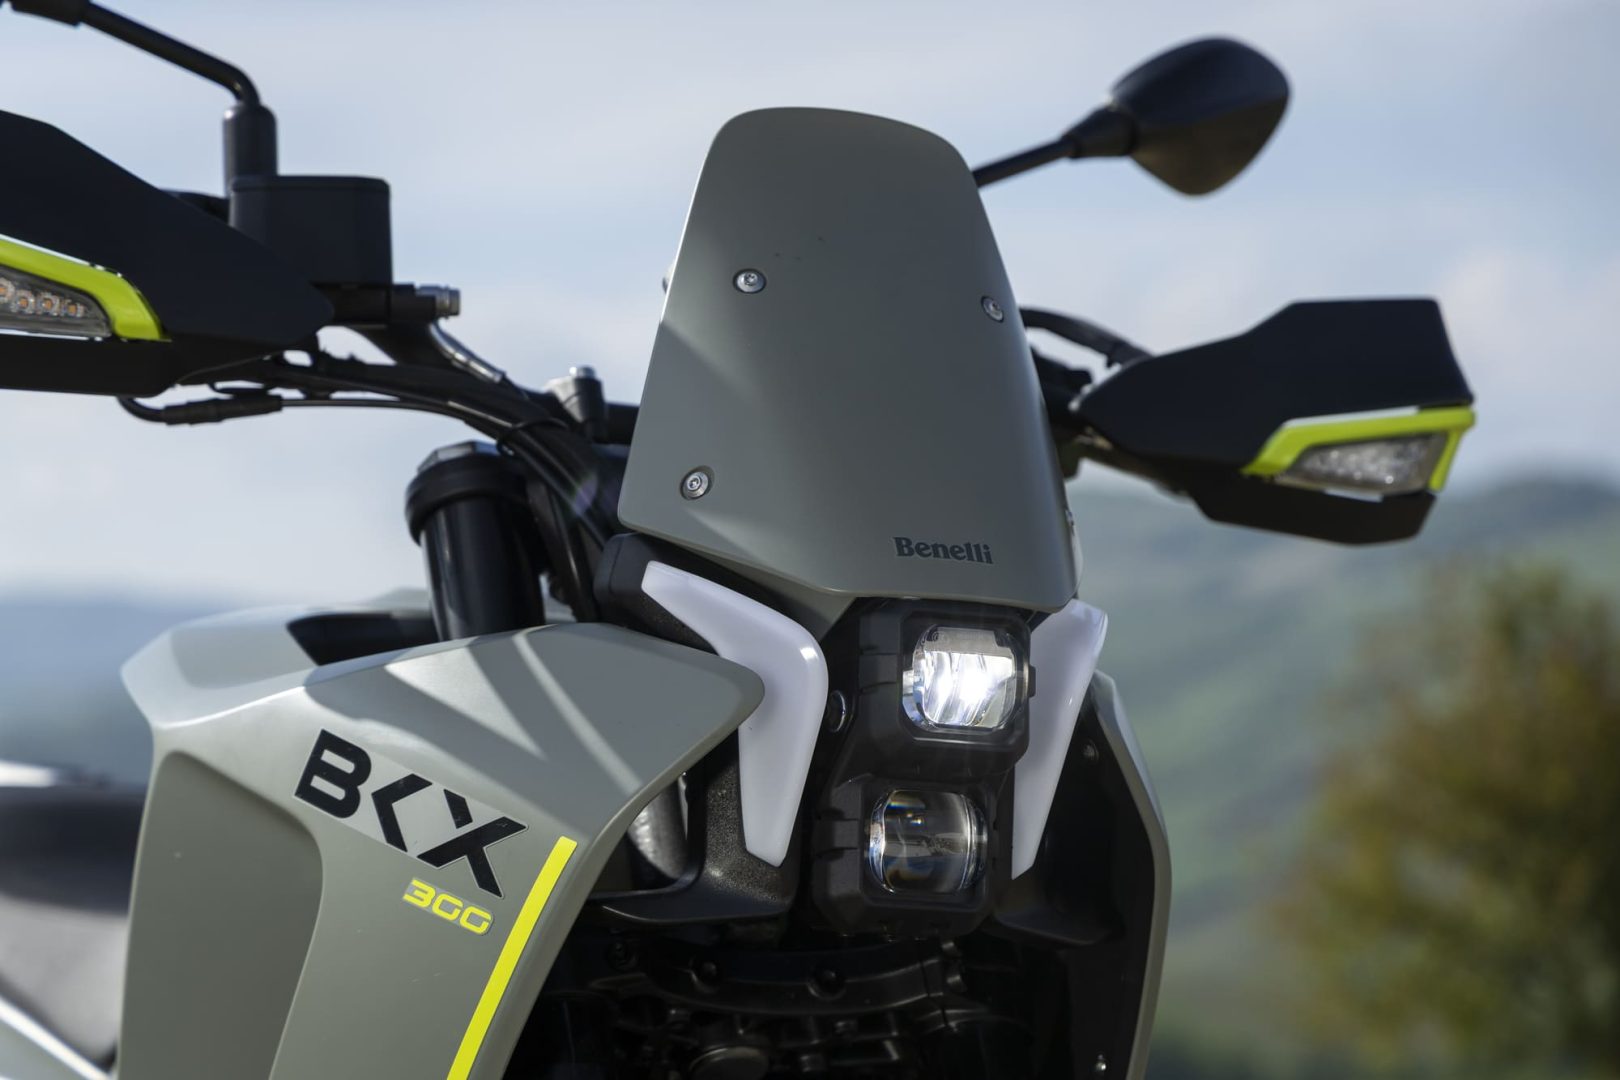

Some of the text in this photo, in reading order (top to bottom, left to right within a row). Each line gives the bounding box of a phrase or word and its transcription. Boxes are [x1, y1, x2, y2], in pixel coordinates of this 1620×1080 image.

[892, 536, 993, 564] Benelli
[294, 728, 527, 898] BKX
[402, 879, 492, 934] 300
